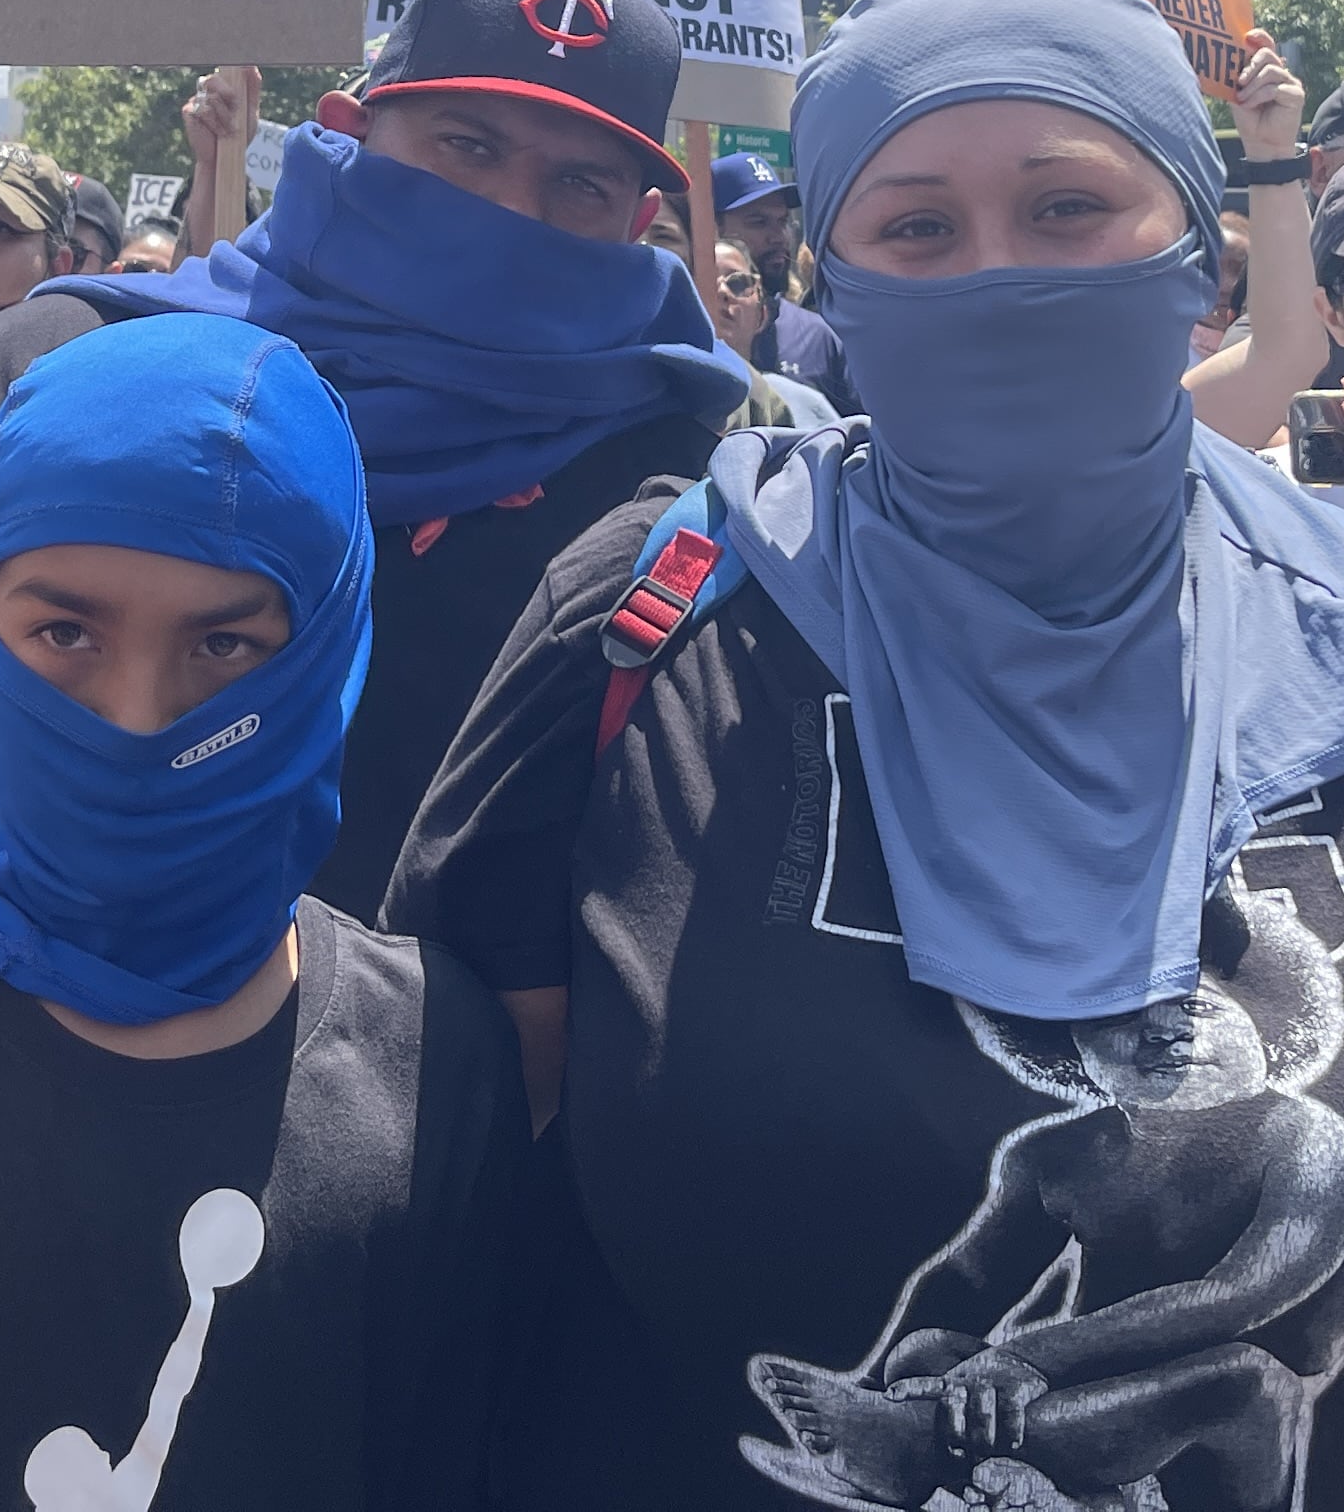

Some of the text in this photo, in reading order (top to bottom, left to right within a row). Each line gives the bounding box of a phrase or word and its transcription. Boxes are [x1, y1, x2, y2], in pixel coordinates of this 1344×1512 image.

[672, 16, 794, 65] RANTS!
[746, 157, 774, 182] LA
[131, 177, 176, 206] ICE
[182, 719, 254, 764] BATTLE
